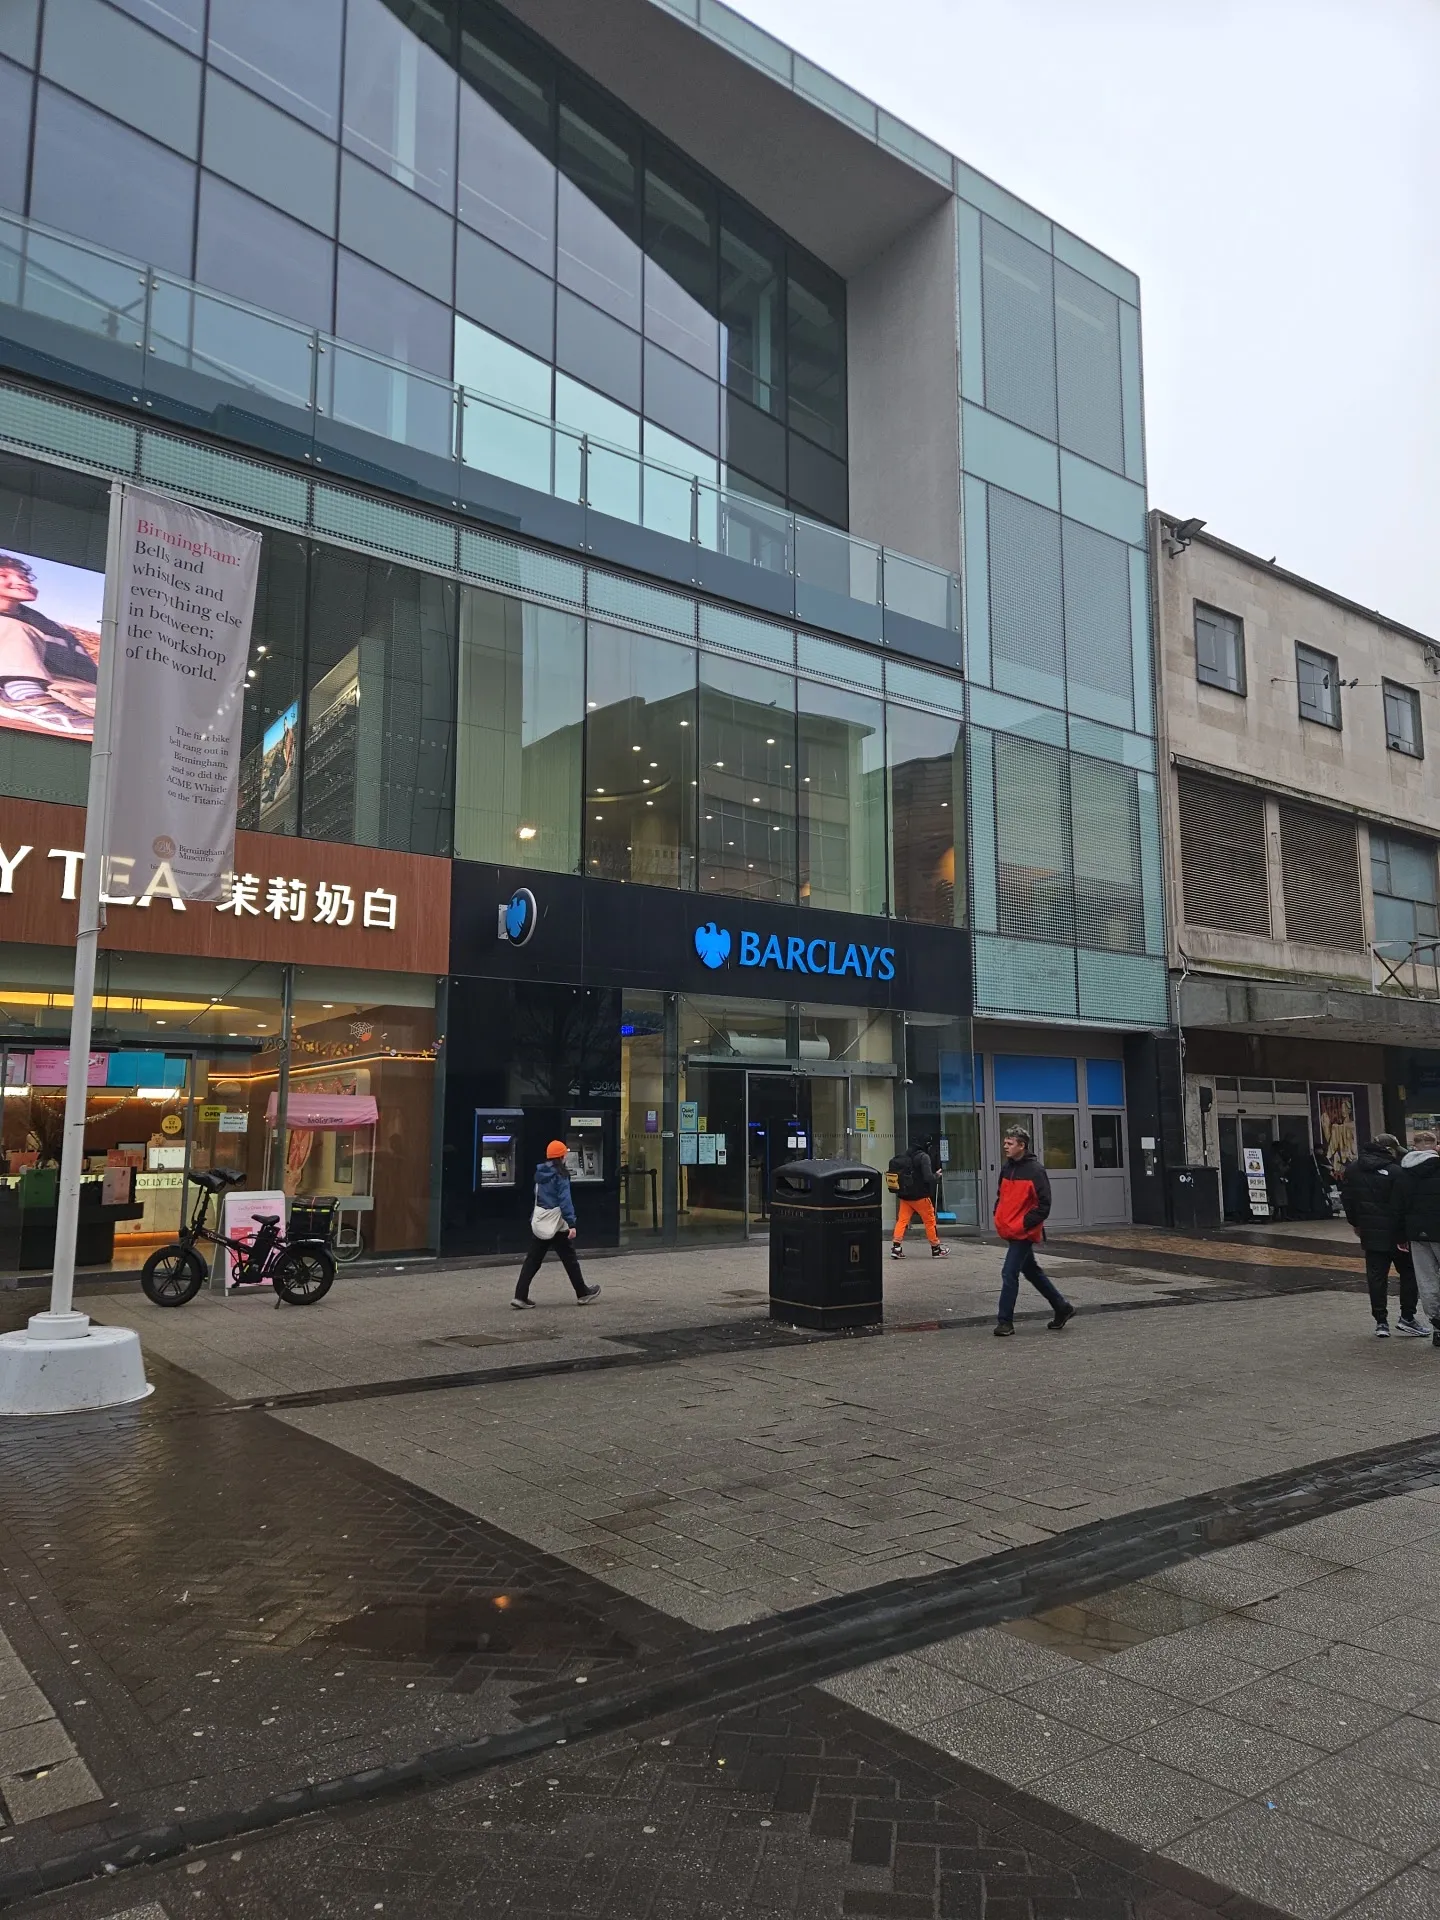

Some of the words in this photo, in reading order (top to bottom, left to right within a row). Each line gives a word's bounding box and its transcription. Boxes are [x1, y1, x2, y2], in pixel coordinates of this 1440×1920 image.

[135, 540, 170, 563] Bells
[174, 560, 204, 574] and
[136, 519, 241, 567] Birmingham:
[132, 563, 190, 592] whistles
[195, 584, 224, 602] and
[128, 602, 144, 618] in
[150, 605, 214, 640] between;
[130, 585, 213, 622] everything
[216, 610, 243, 628] else
[128, 624, 152, 640] the
[158, 631, 226, 666] workshop
[126, 646, 143, 660] of
[146, 647, 170, 665] the
[172, 660, 217, 682] world.
[170, 736, 181, 748] bell
[183, 744, 202, 755] rang
[221, 748, 229, 756] in
[176, 726, 192, 738] The
[194, 732, 210, 742] firt
[212, 734, 230, 743] bike
[171, 766, 184, 774] and
[197, 771, 212, 779] did
[214, 773, 228, 781] the
[174, 751, 228, 770] Birmingham,
[166, 774, 192, 790] ACME
[195, 783, 227, 793] Whistle
[178, 793, 190, 802] the
[179, 844, 225, 856] Birmingham
[179, 852, 214, 862] Museums
[47, 848, 187, 911] TEA
[215, 871, 398, 931] 茉莉奶白
[740, 930, 895, 980] BARCLAYS
[136, 1178, 163, 1186] OLLY
[165, 1178, 183, 1186] TEA
